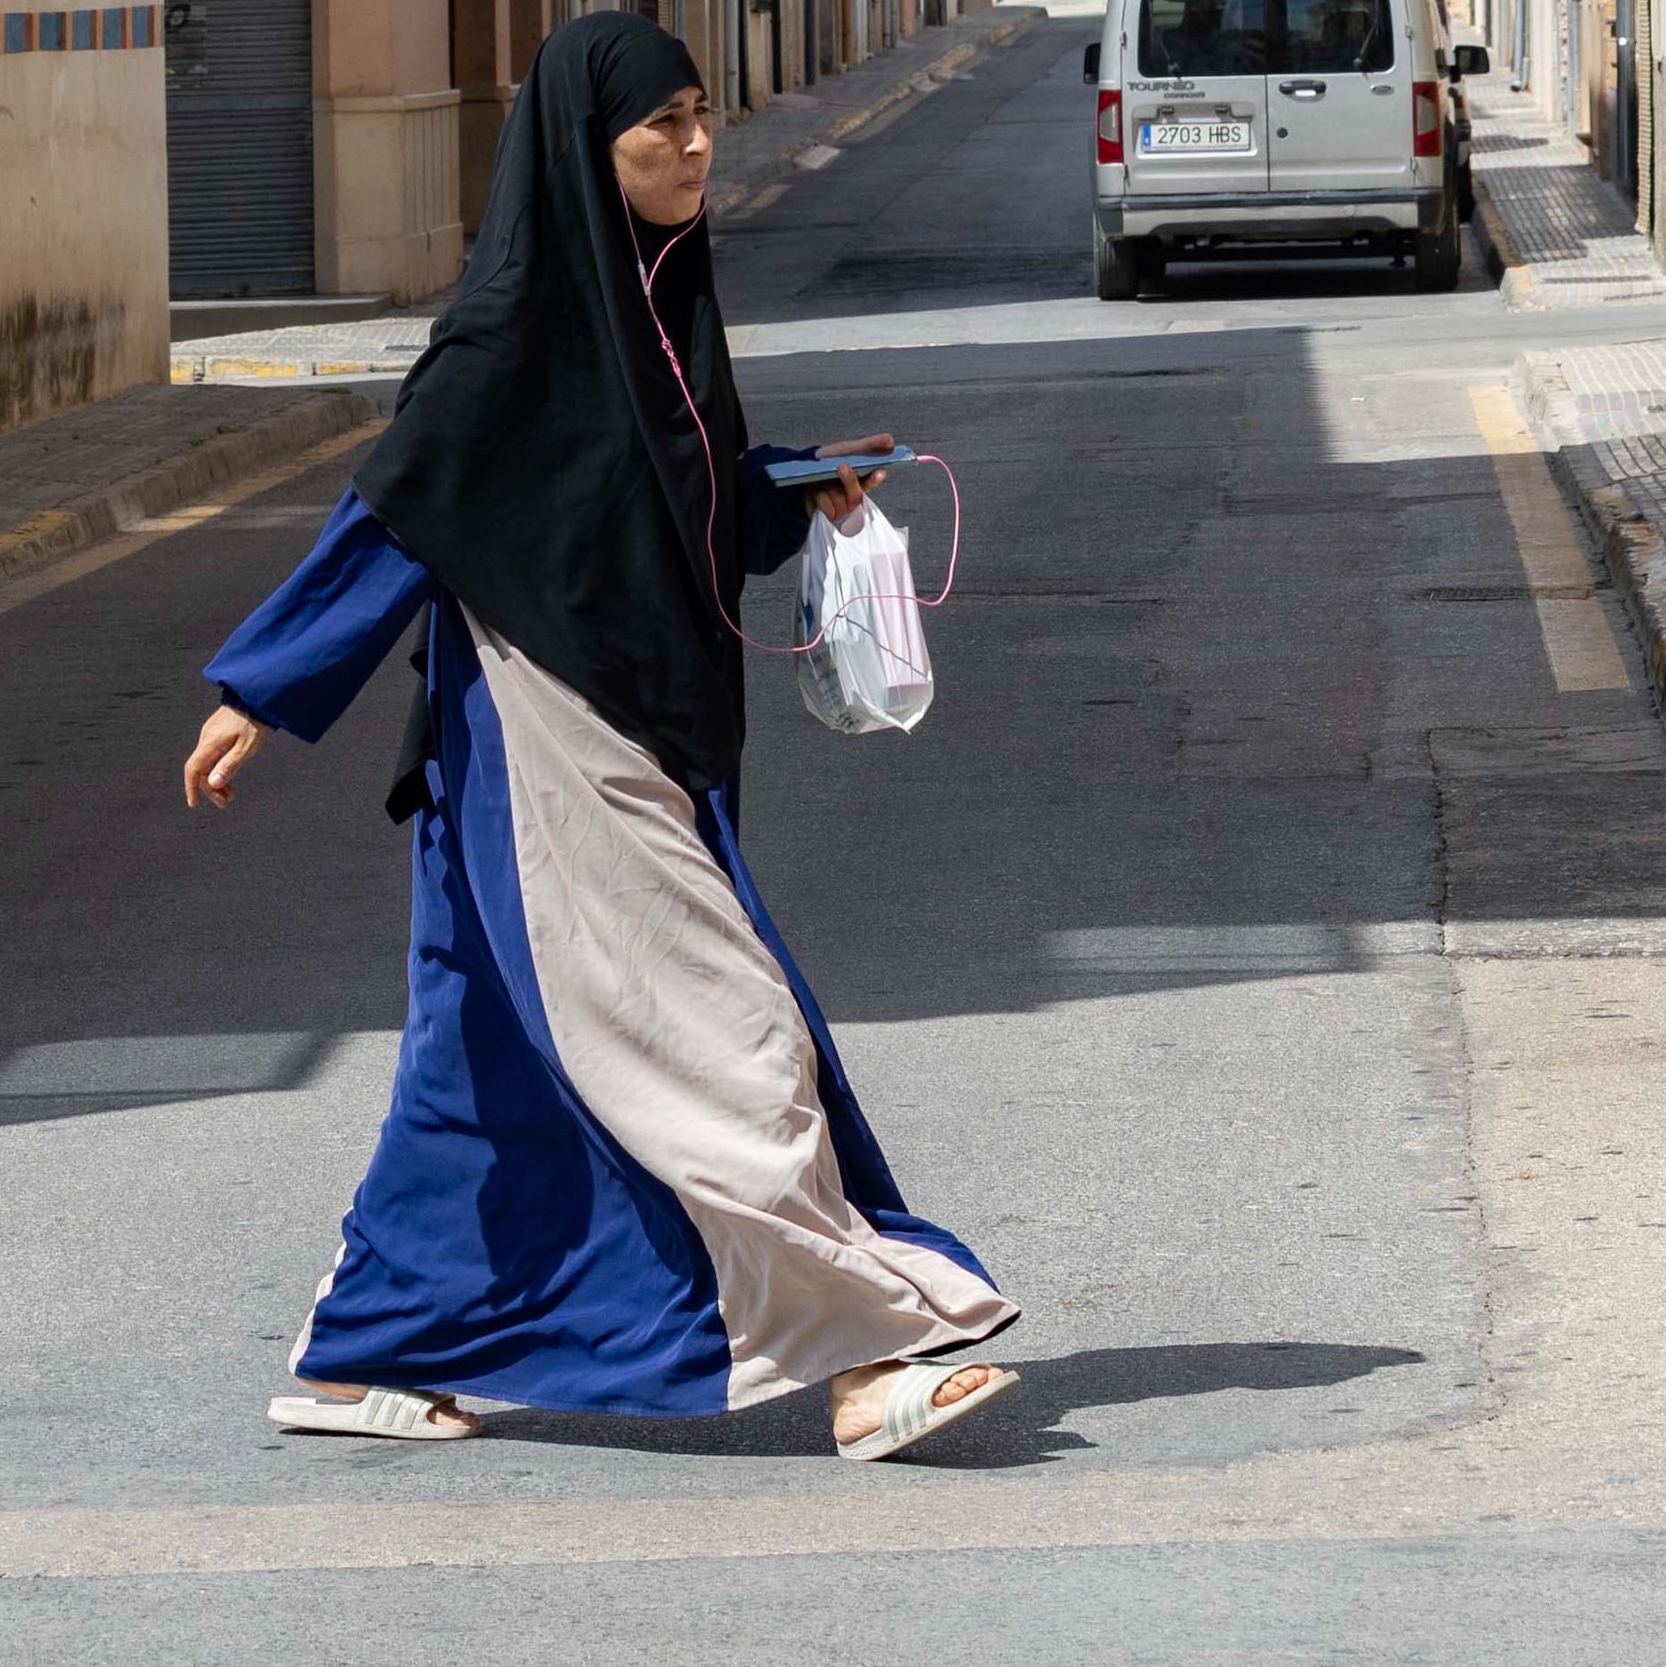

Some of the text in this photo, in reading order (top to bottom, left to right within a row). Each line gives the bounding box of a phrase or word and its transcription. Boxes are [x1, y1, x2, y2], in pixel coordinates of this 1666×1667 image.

[1127, 80, 1195, 92] TOURNEO
[1158, 126, 1241, 144] 2703 HBS
